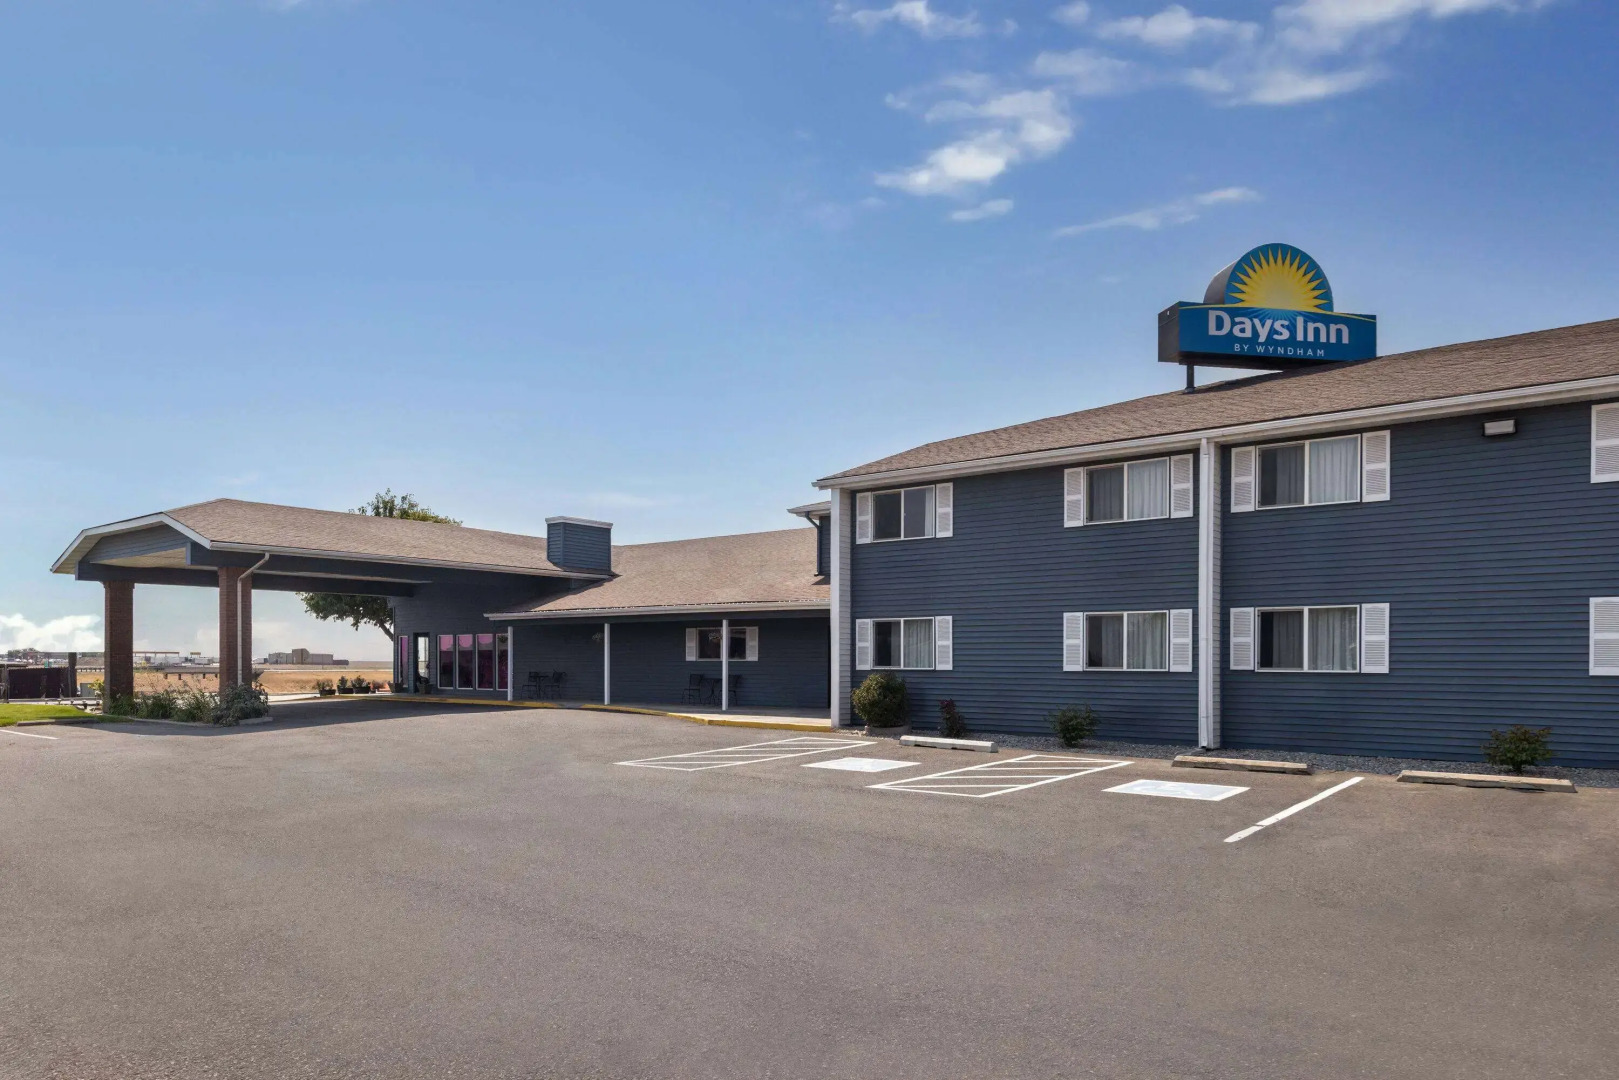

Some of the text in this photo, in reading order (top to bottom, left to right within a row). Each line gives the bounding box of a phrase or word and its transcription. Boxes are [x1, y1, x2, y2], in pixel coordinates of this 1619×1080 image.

[1208, 310, 1349, 344] Days Inn
[1234, 343, 1325, 357] BY WYNDHAM
